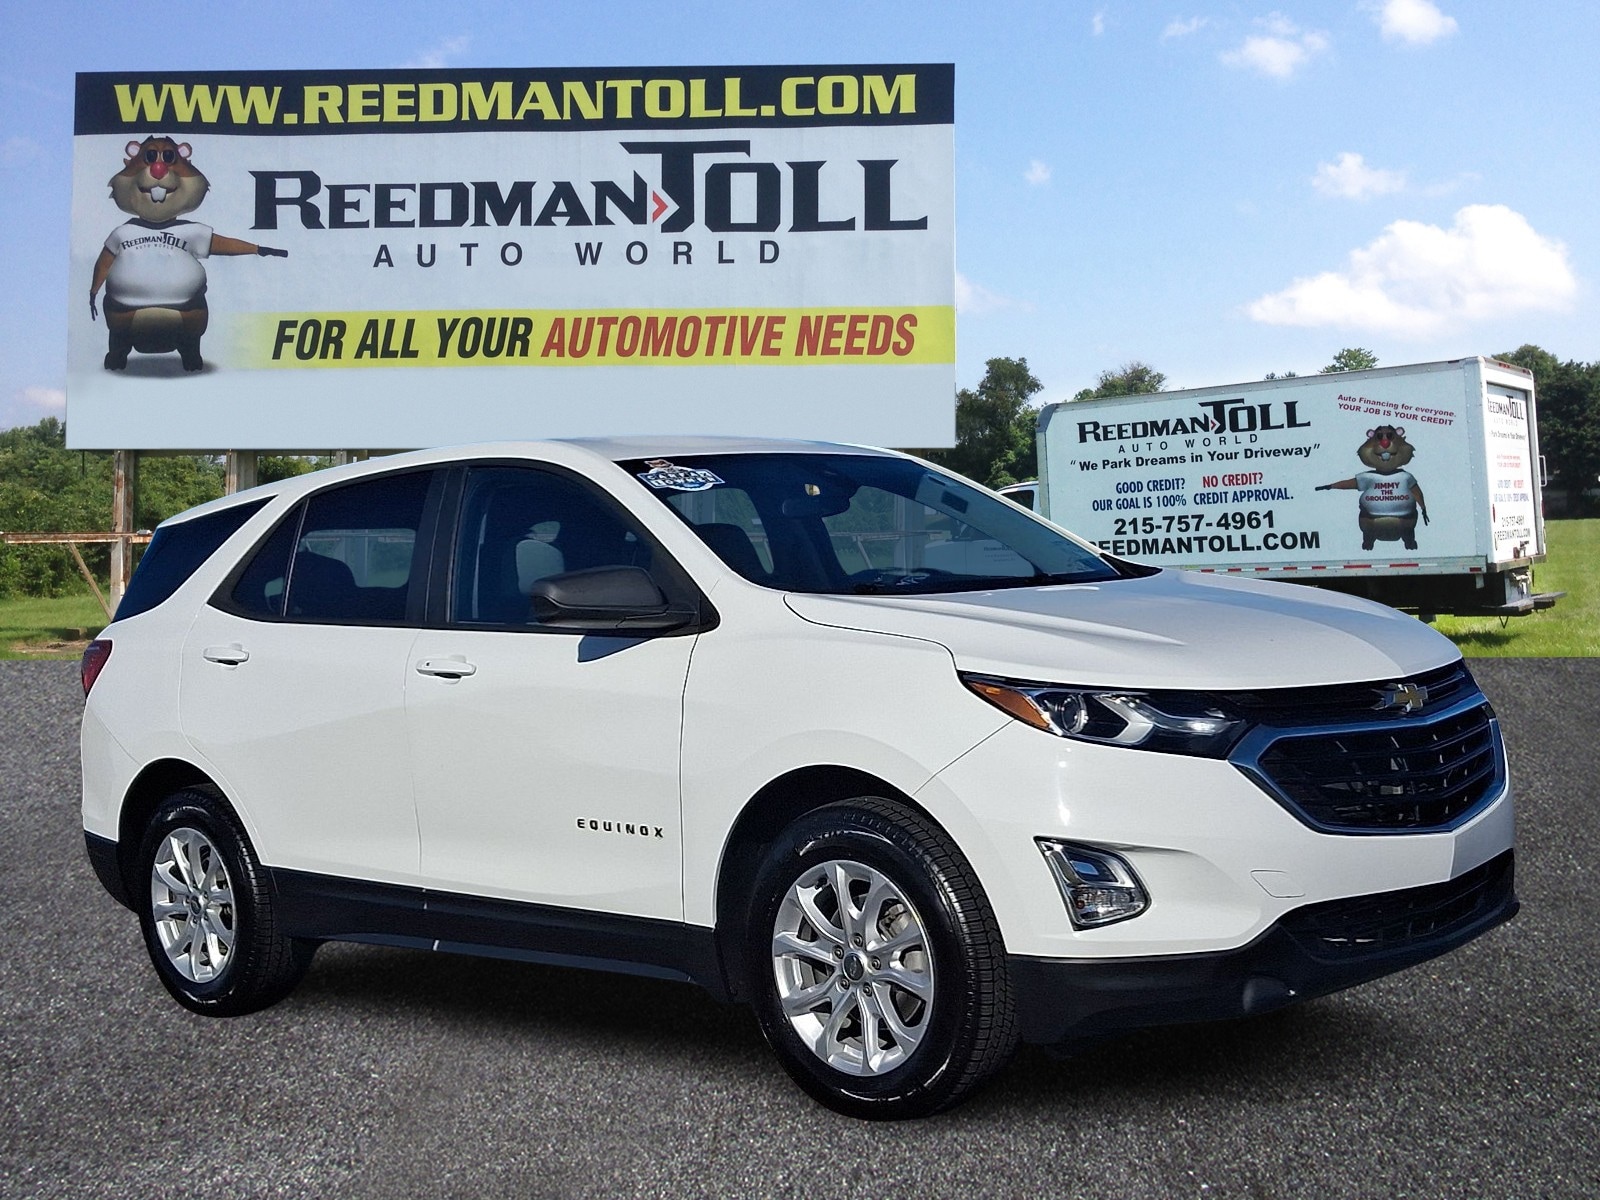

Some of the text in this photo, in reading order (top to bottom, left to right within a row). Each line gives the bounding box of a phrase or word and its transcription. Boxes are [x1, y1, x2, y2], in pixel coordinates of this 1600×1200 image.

[114, 74, 917, 125] WWW.REEDMANTOLL.COM
[373, 240, 780, 268] AUTO WORLD
[272, 313, 918, 361] FOR ALL YOUR AUTOMOTIVE NEEDS
[1337, 394, 1457, 418] Auto Financing for everyone.
[1338, 403, 1362, 412] YOUR
[1363, 407, 1381, 415] JOB
[1394, 411, 1419, 421] YOUR
[1420, 415, 1454, 426] CREDIT
[1118, 434, 1258, 454] AUTO WORLD
[1102, 458, 1131, 469] Park
[1135, 455, 1186, 467] Dreams
[1190, 453, 1203, 462] in
[1207, 450, 1240, 461] Your
[1116, 477, 1186, 494] GOOD CREDIT?
[1202, 472, 1263, 488] NO CREDIT?
[1374, 482, 1400, 490] JIMMY
[1092, 487, 1294, 512] OUR GOAL IS 100% CREDIT APPROVAL.
[1365, 494, 1410, 502] GROUNDHOG
[1113, 509, 1274, 536] 215-757-4961
[576, 818, 664, 838] EQUINOX
